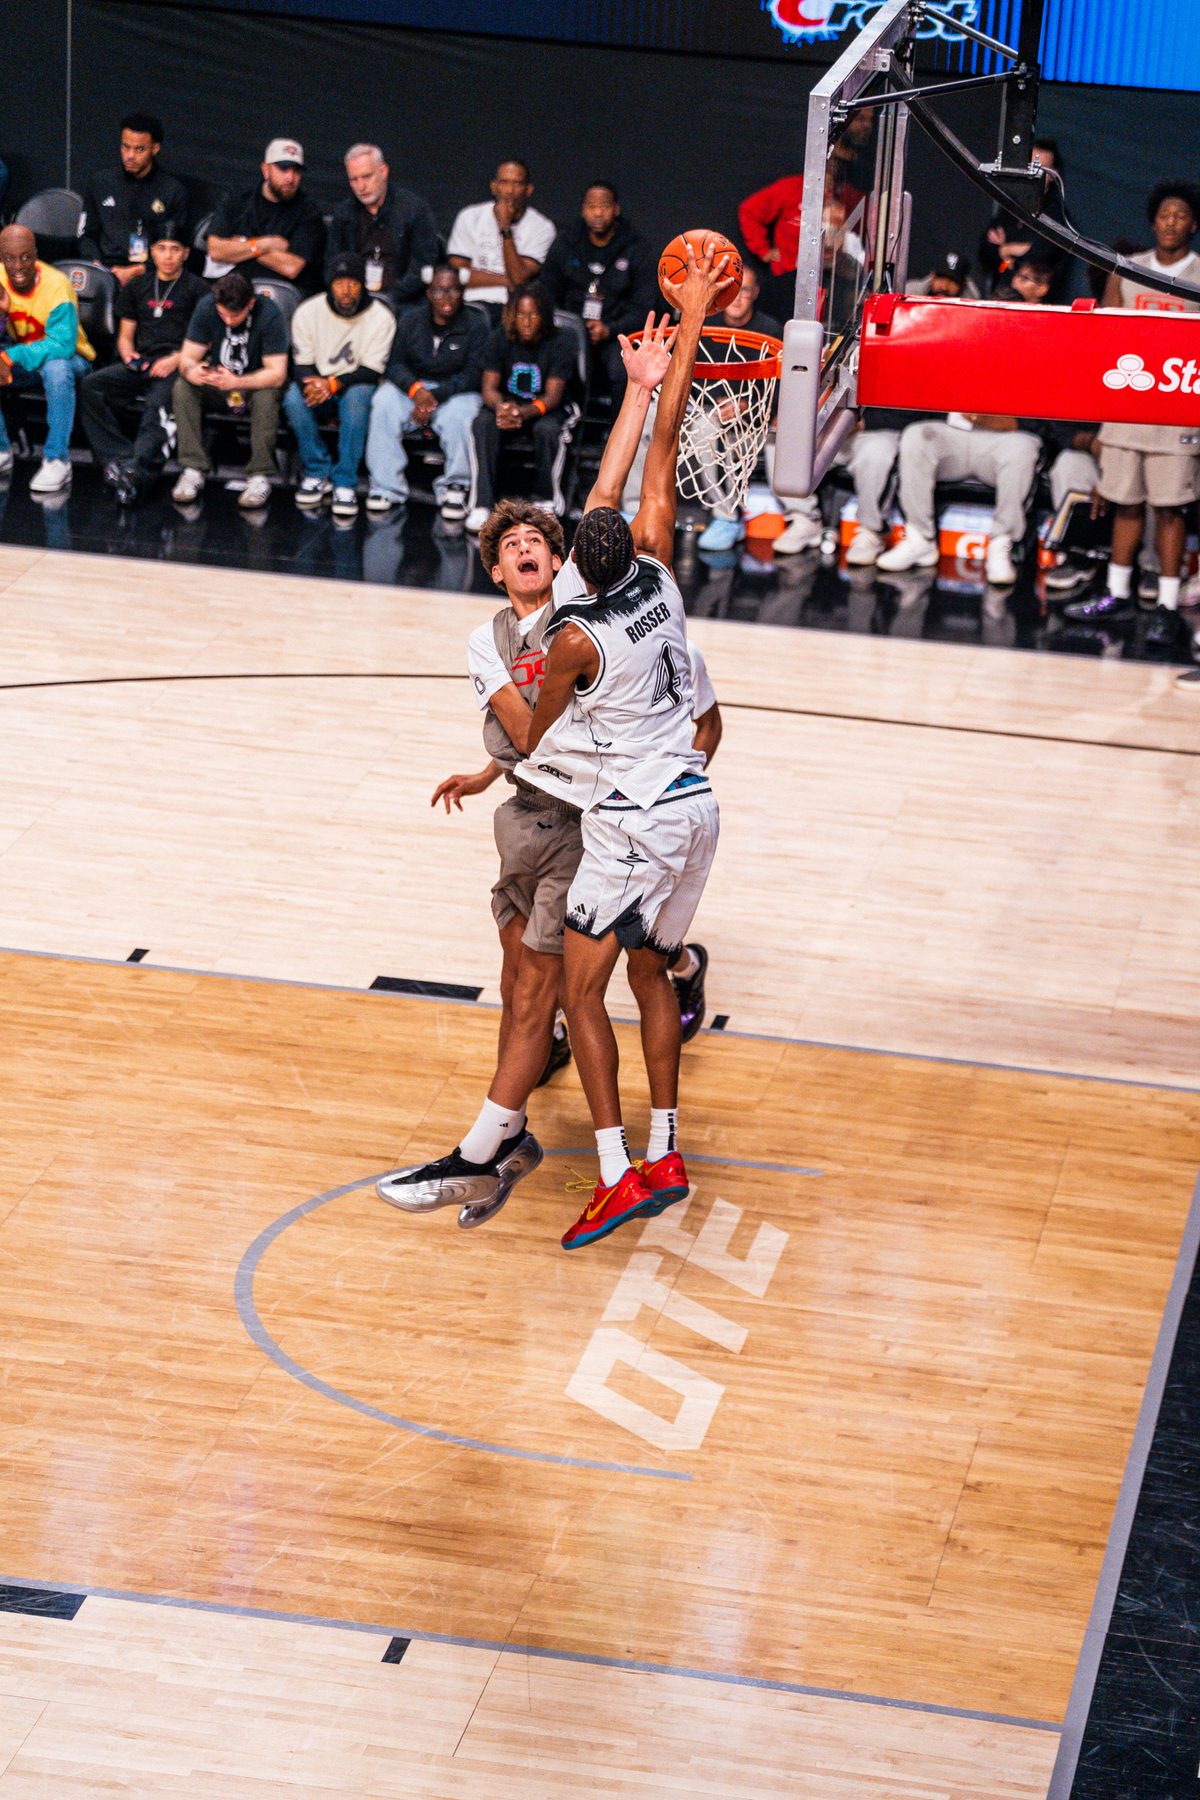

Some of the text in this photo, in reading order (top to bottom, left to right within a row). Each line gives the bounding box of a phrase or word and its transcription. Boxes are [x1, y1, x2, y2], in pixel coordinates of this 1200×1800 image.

[624, 601, 671, 645] ROSSER
[651, 640, 683, 707] 4
[563, 1183, 790, 1451] OTE
